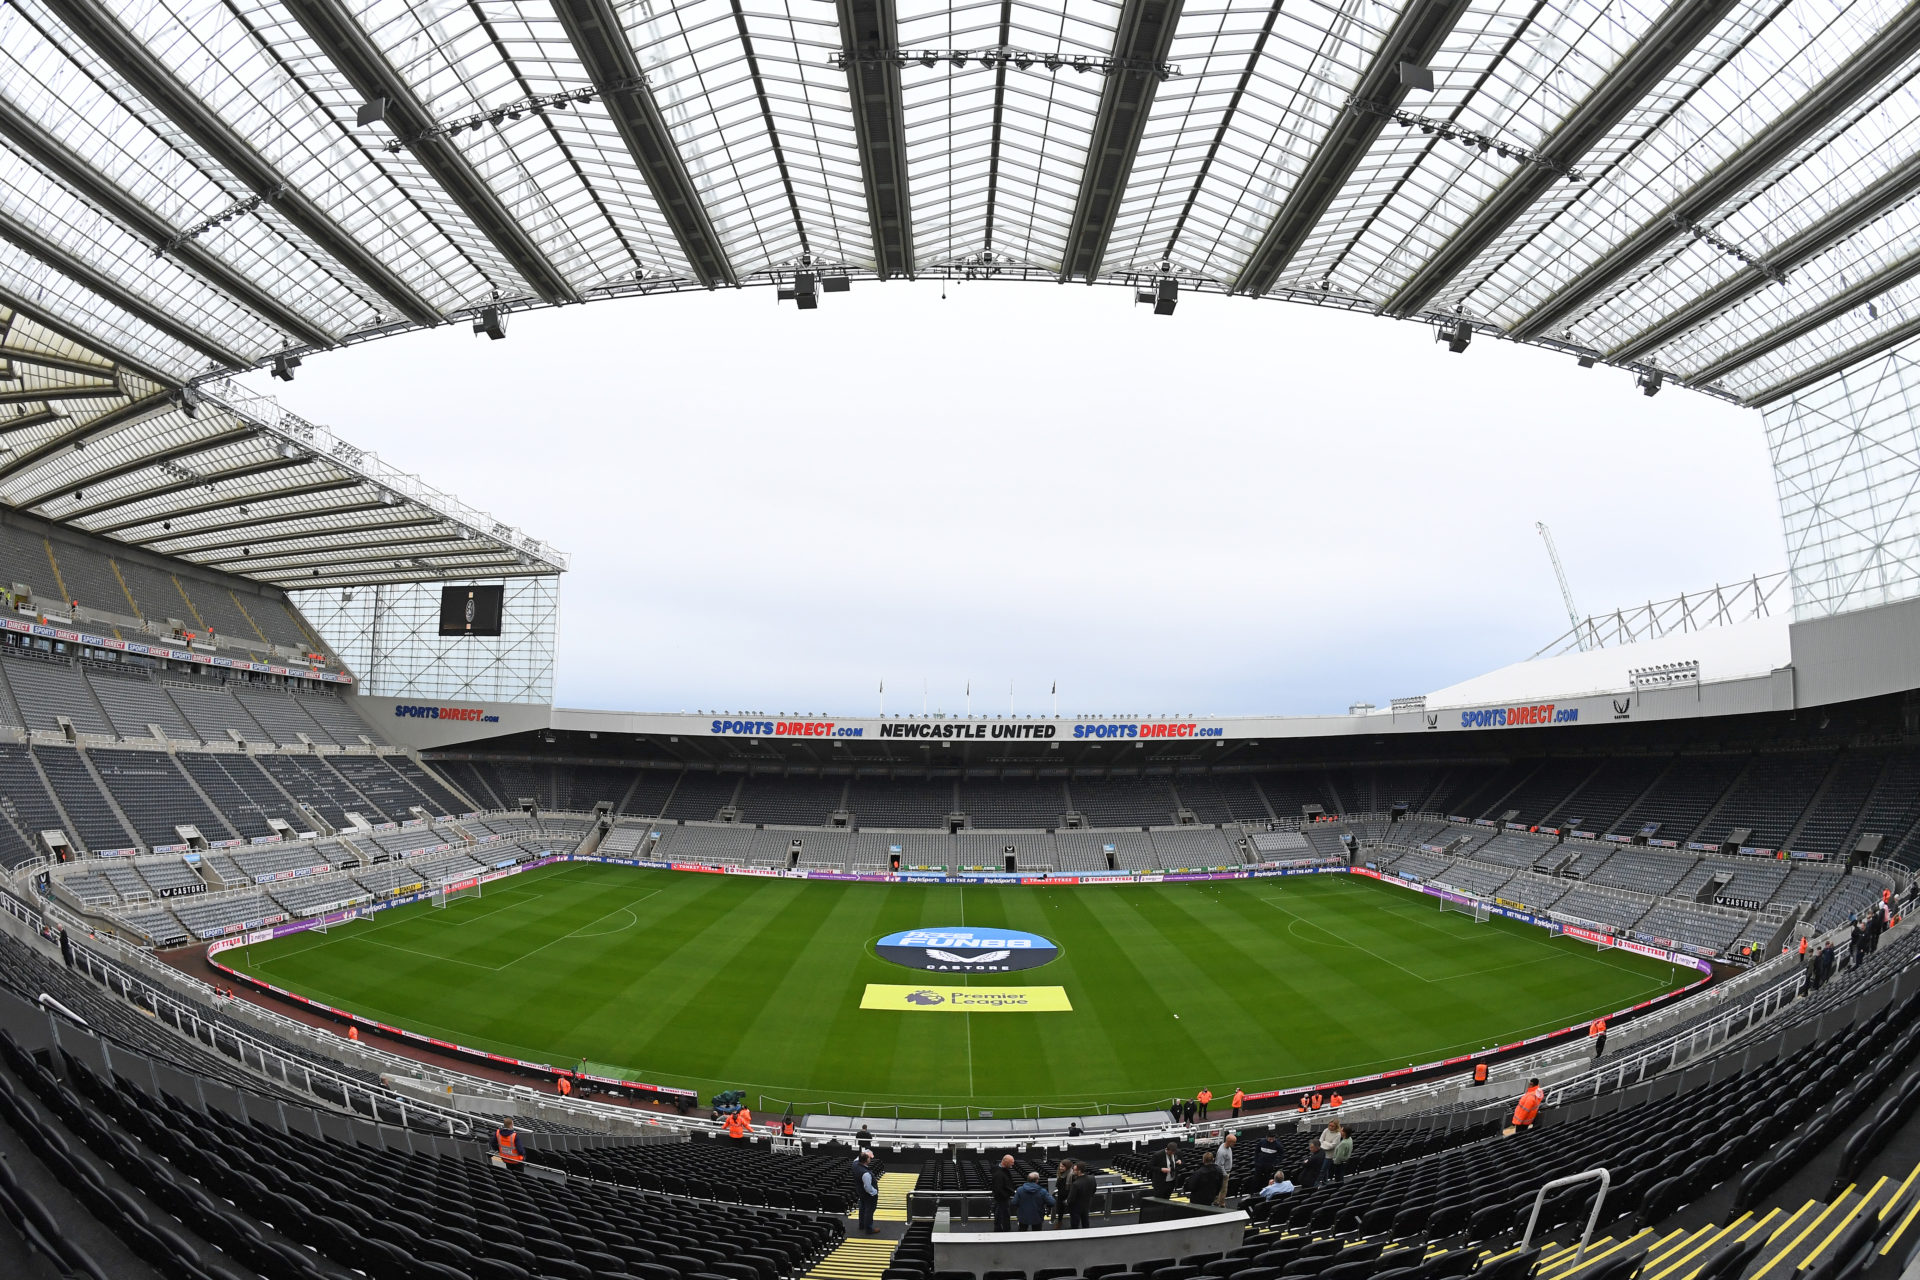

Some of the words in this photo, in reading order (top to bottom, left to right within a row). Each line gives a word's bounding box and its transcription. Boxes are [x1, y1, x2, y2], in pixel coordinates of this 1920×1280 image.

[34, 626, 56, 637] SPORTS
[82, 635, 103, 645] SPORTS
[129, 643, 149, 653] SPORTS
[880, 723, 986, 738] NEWCASTLE
[991, 724, 1056, 739] UNITED
[172, 884, 205, 896] CASTORE
[1725, 898, 1758, 909] CASTORE
[204, 928, 224, 938] SPORTS
[1636, 932, 1654, 941] SPORTS
[899, 937, 1032, 948] FUN88
[1624, 941, 1646, 951] TOMKET
[951, 992, 1027, 1000] Premier
[951, 998, 1029, 1006] League
